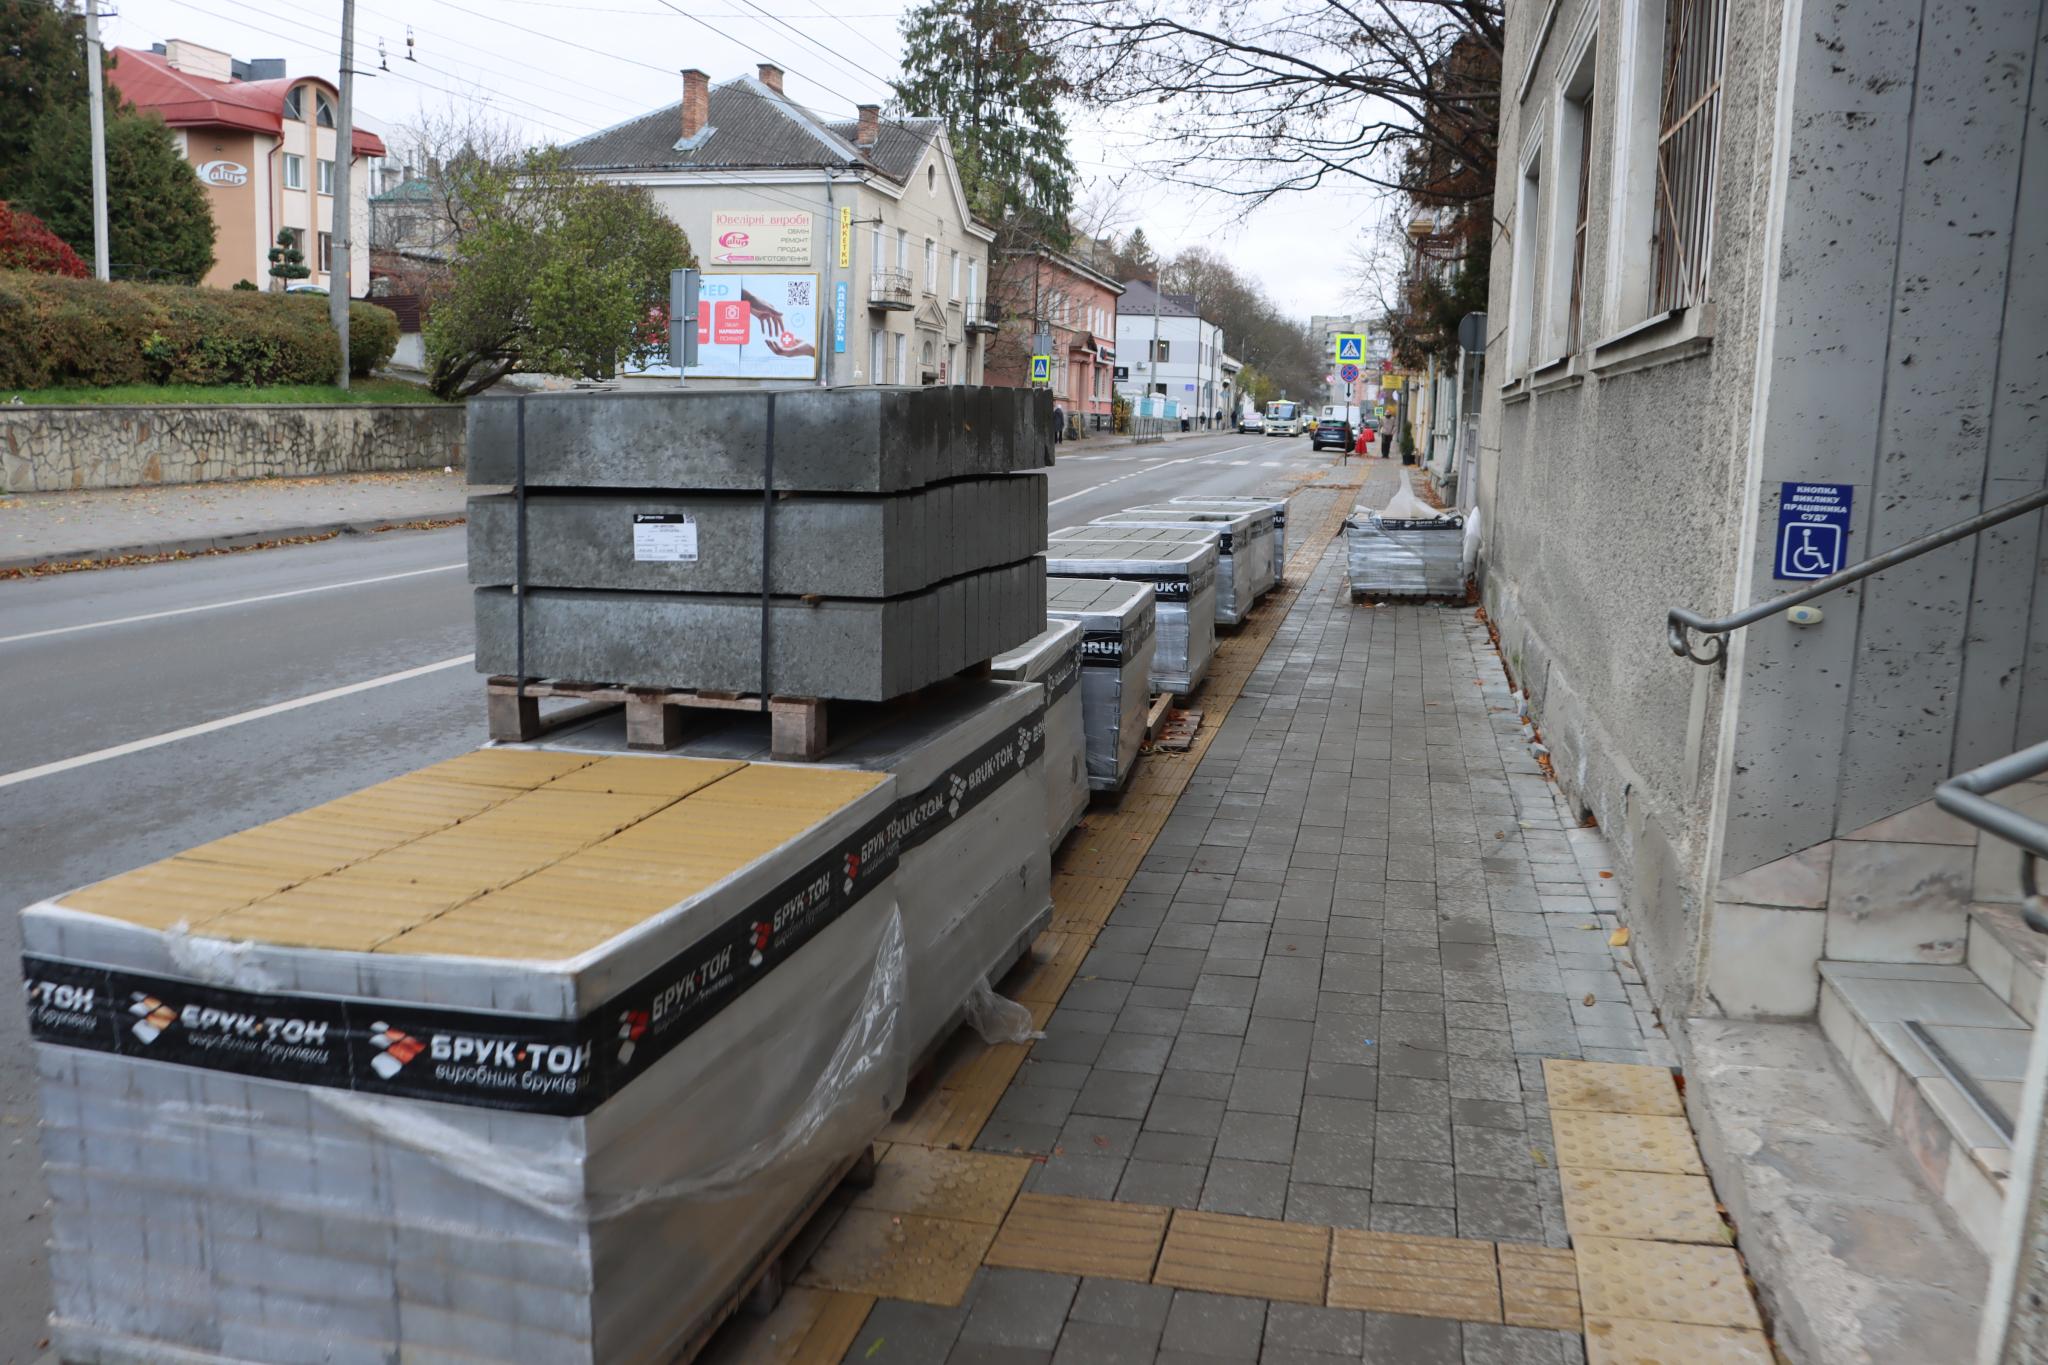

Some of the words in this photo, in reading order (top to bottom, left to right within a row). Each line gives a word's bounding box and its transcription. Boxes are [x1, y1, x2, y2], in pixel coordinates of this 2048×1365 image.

[770, 213, 809, 226] вироби
[1797, 486, 1837, 494] КНОПКА
[1792, 495, 1840, 504] ВИКЛИКУ
[1783, 503, 1847, 513] ПРАЦІВНИКА
[1801, 513, 1828, 522] СУДУ
[435, 1063, 518, 1088] виробник
